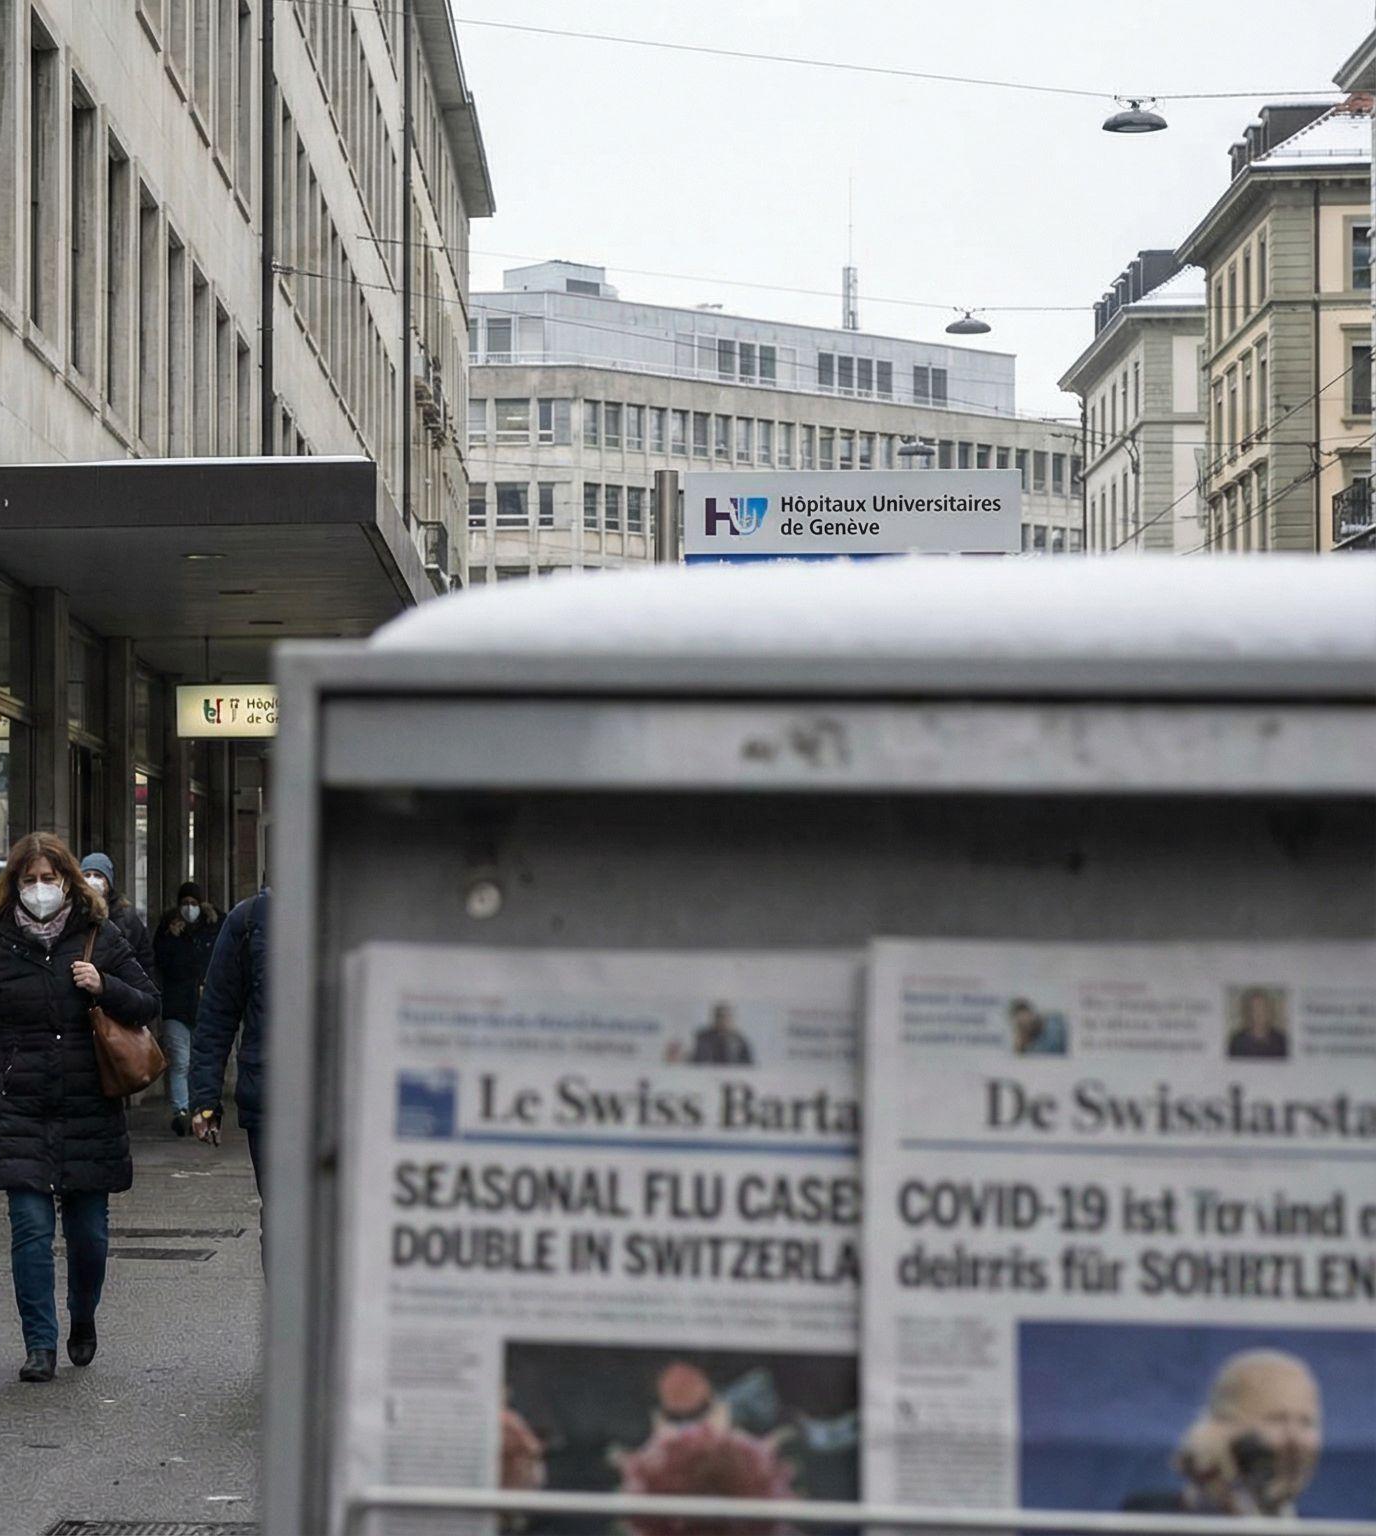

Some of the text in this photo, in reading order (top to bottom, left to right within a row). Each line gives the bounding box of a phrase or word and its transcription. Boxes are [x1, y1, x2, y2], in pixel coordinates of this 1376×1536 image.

[780, 516, 880, 536] de Genève
[781, 494, 1002, 516] Hôpitaux Universitaires
[247, 713, 261, 724] de
[478, 1075, 541, 1125] Le
[554, 1076, 702, 1127] Swiss
[986, 1079, 1055, 1130] De
[392, 1161, 862, 1226] SEASONAL FLU CASE
[898, 1180, 1109, 1233] COVID-19
[391, 1225, 557, 1272] DOUBLE
[570, 1231, 609, 1271] IN
[1061, 1247, 1121, 1292] für
